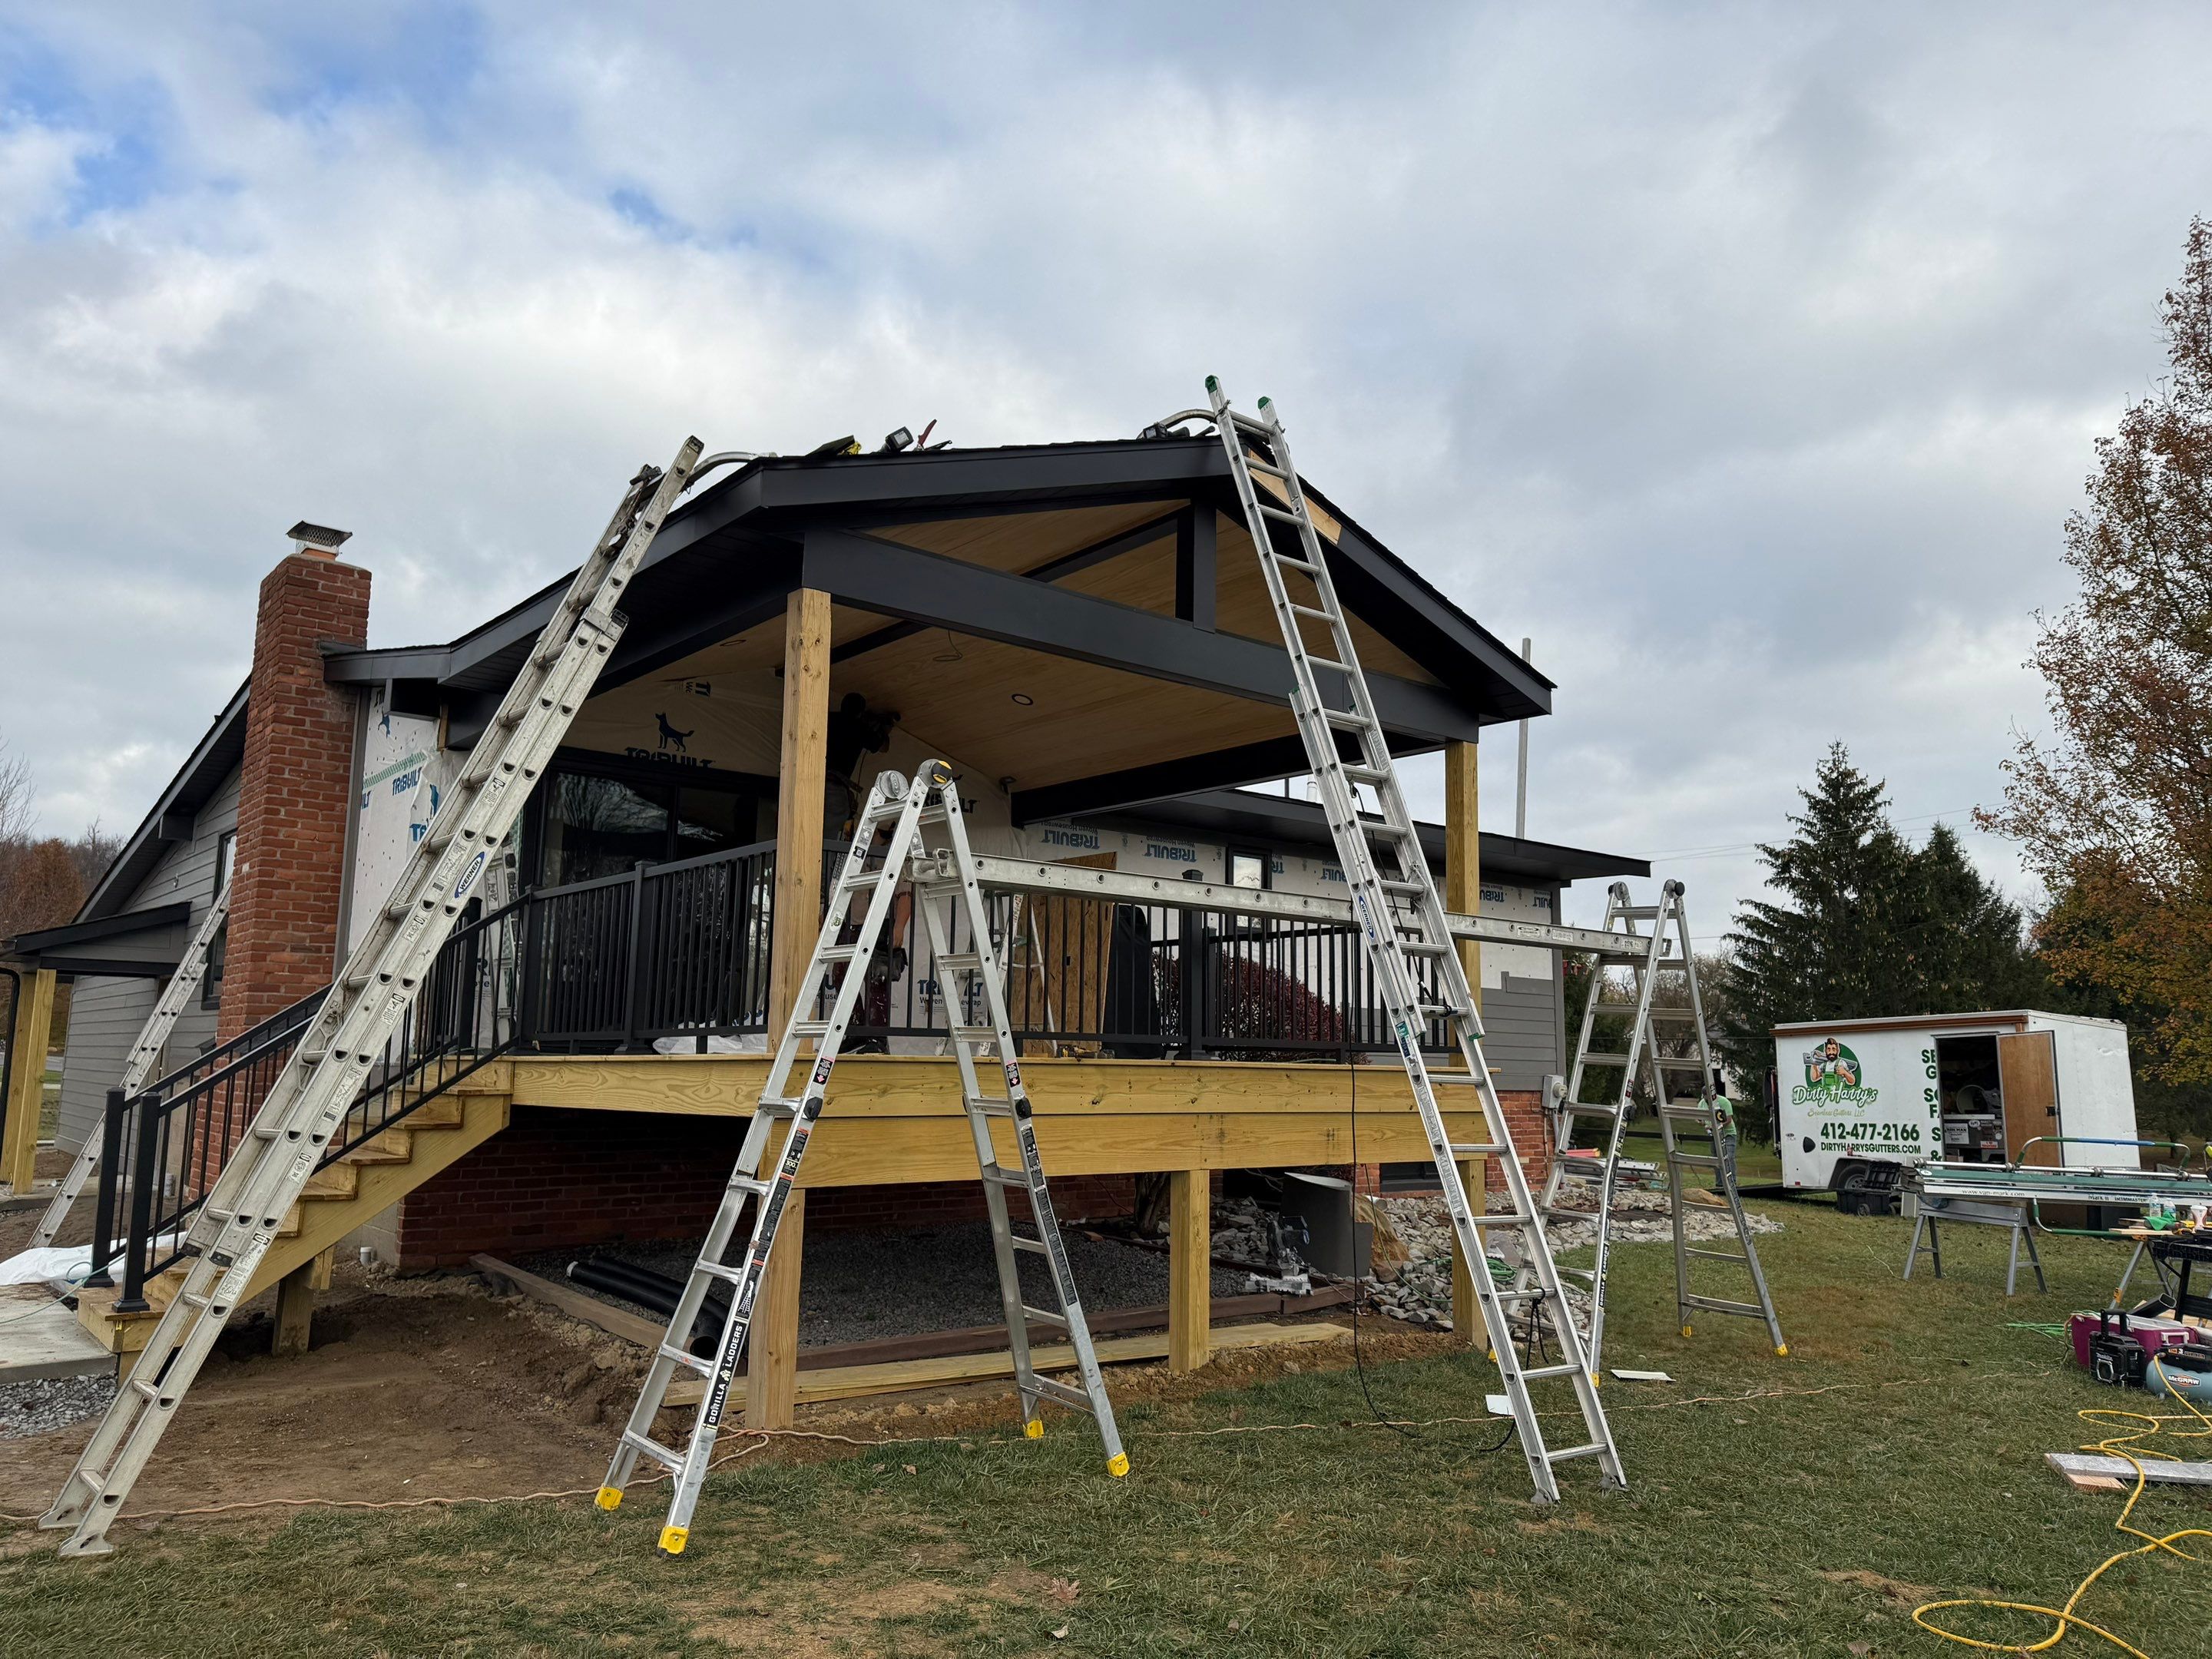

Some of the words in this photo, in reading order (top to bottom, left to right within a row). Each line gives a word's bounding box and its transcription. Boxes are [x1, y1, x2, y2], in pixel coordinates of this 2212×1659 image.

[392, 767, 422, 796] TRIBUILT
[1040, 830, 1100, 849] TRIBUILT
[1143, 844, 1197, 863] TRIBUILT
[459, 860, 480, 890] WERNER
[1361, 904, 1372, 930] WERNER
[1793, 1085, 1829, 1107] Dirty
[1829, 1081, 1878, 1108] Harry's
[1820, 1122, 1920, 1141] 412-477-2166
[708, 1383, 727, 1423] GORILLA
[724, 1324, 743, 1368] LADDERS
